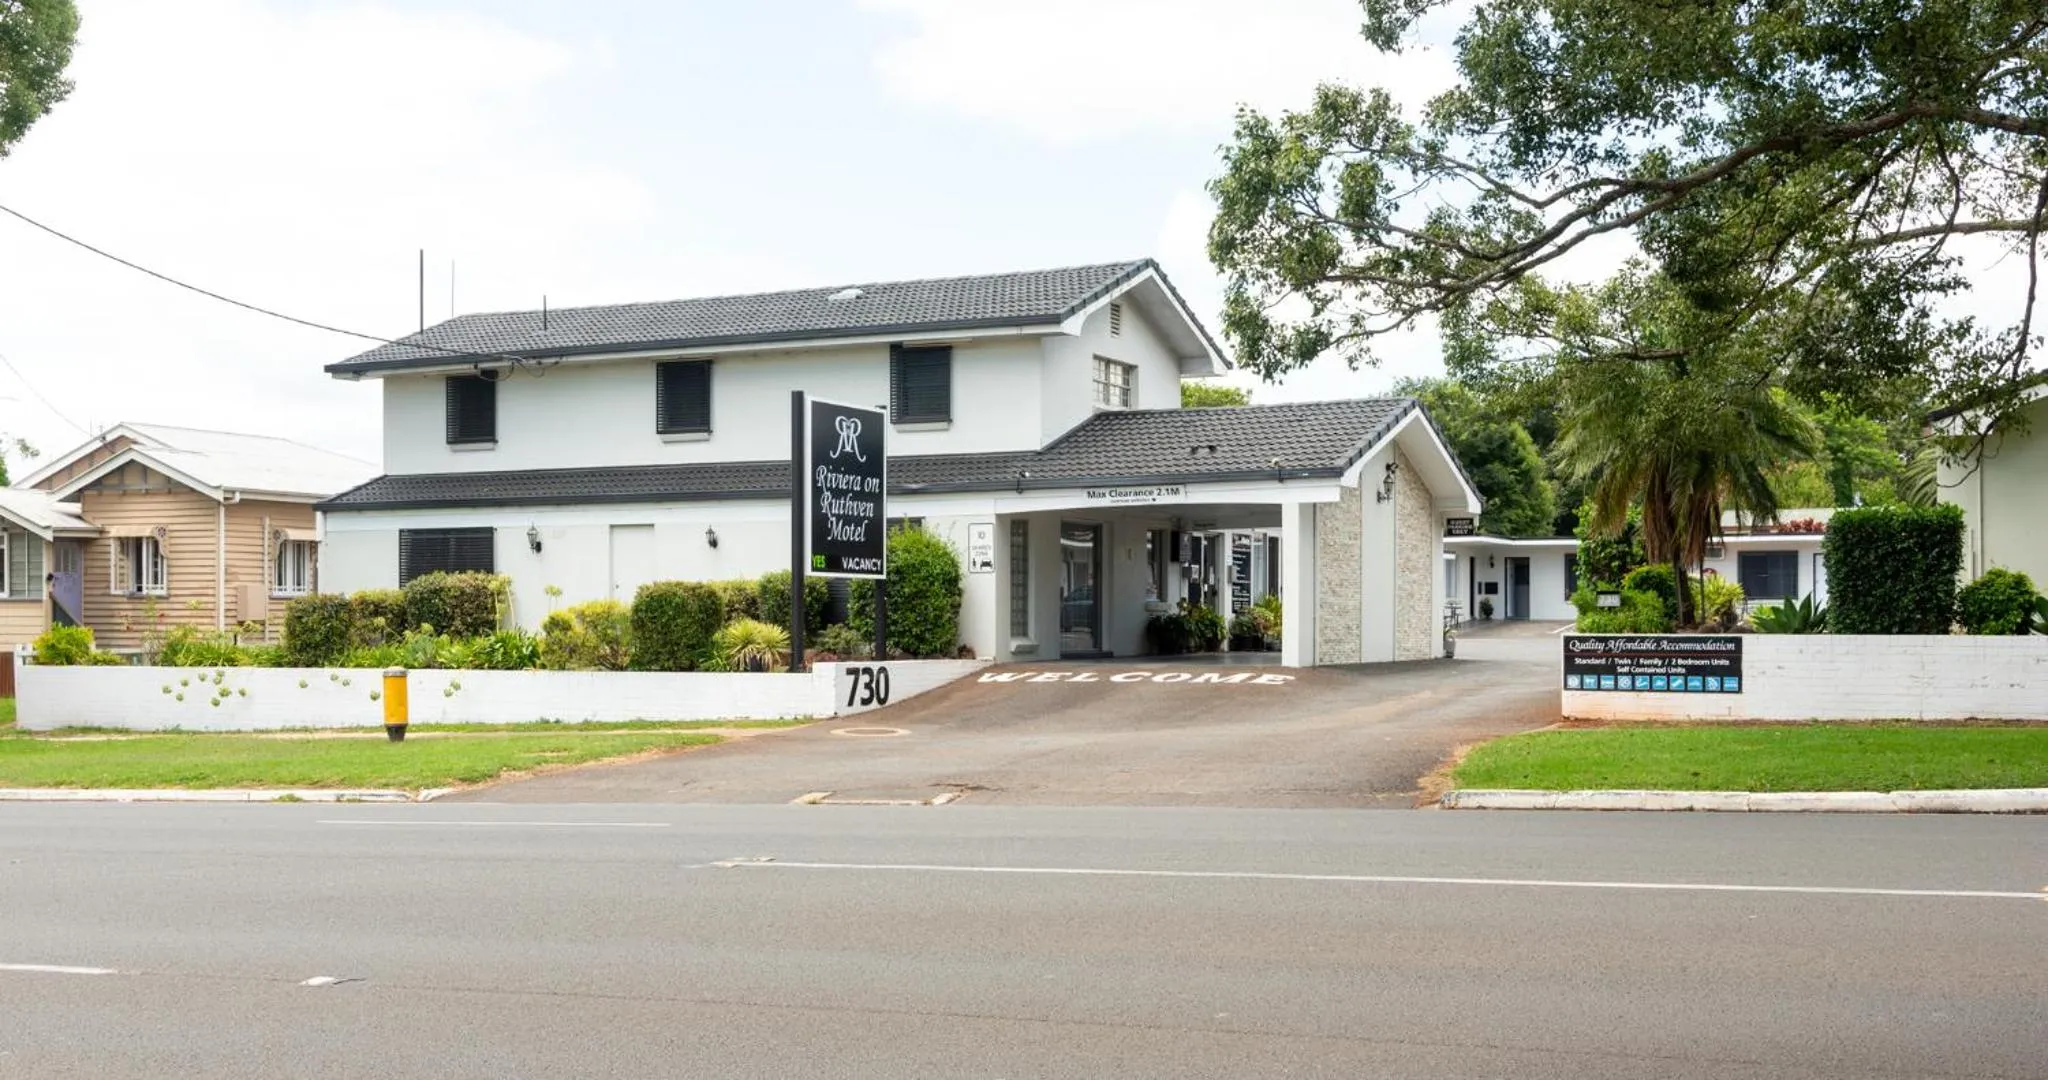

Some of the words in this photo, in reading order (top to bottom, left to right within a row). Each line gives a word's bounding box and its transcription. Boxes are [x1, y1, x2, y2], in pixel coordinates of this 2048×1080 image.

[816, 465, 861, 493] Riviera
[864, 477, 880, 493] on
[1087, 490, 1106, 499] Max
[1109, 488, 1155, 498] Clearance
[1156, 487, 1180, 497] 2.1M
[820, 492, 874, 519] Ruthven
[827, 517, 868, 542] Motel
[813, 555, 826, 569] YES
[841, 556, 882, 571] VACANCY
[1569, 639, 1605, 653] Quality
[1605, 638, 1657, 653] Affordable
[1658, 639, 1735, 651] Accommodation
[1574, 657, 1607, 665] Standard
[1614, 657, 1632, 665] Twin
[1639, 657, 1662, 667] Family
[1677, 658, 1710, 666] Bedroom
[1711, 658, 1730, 666] Units
[1631, 666, 1667, 674] Contained
[1667, 666, 1686, 674] Units
[976, 671, 1297, 685] WELCOME
[845, 666, 890, 707] 730
